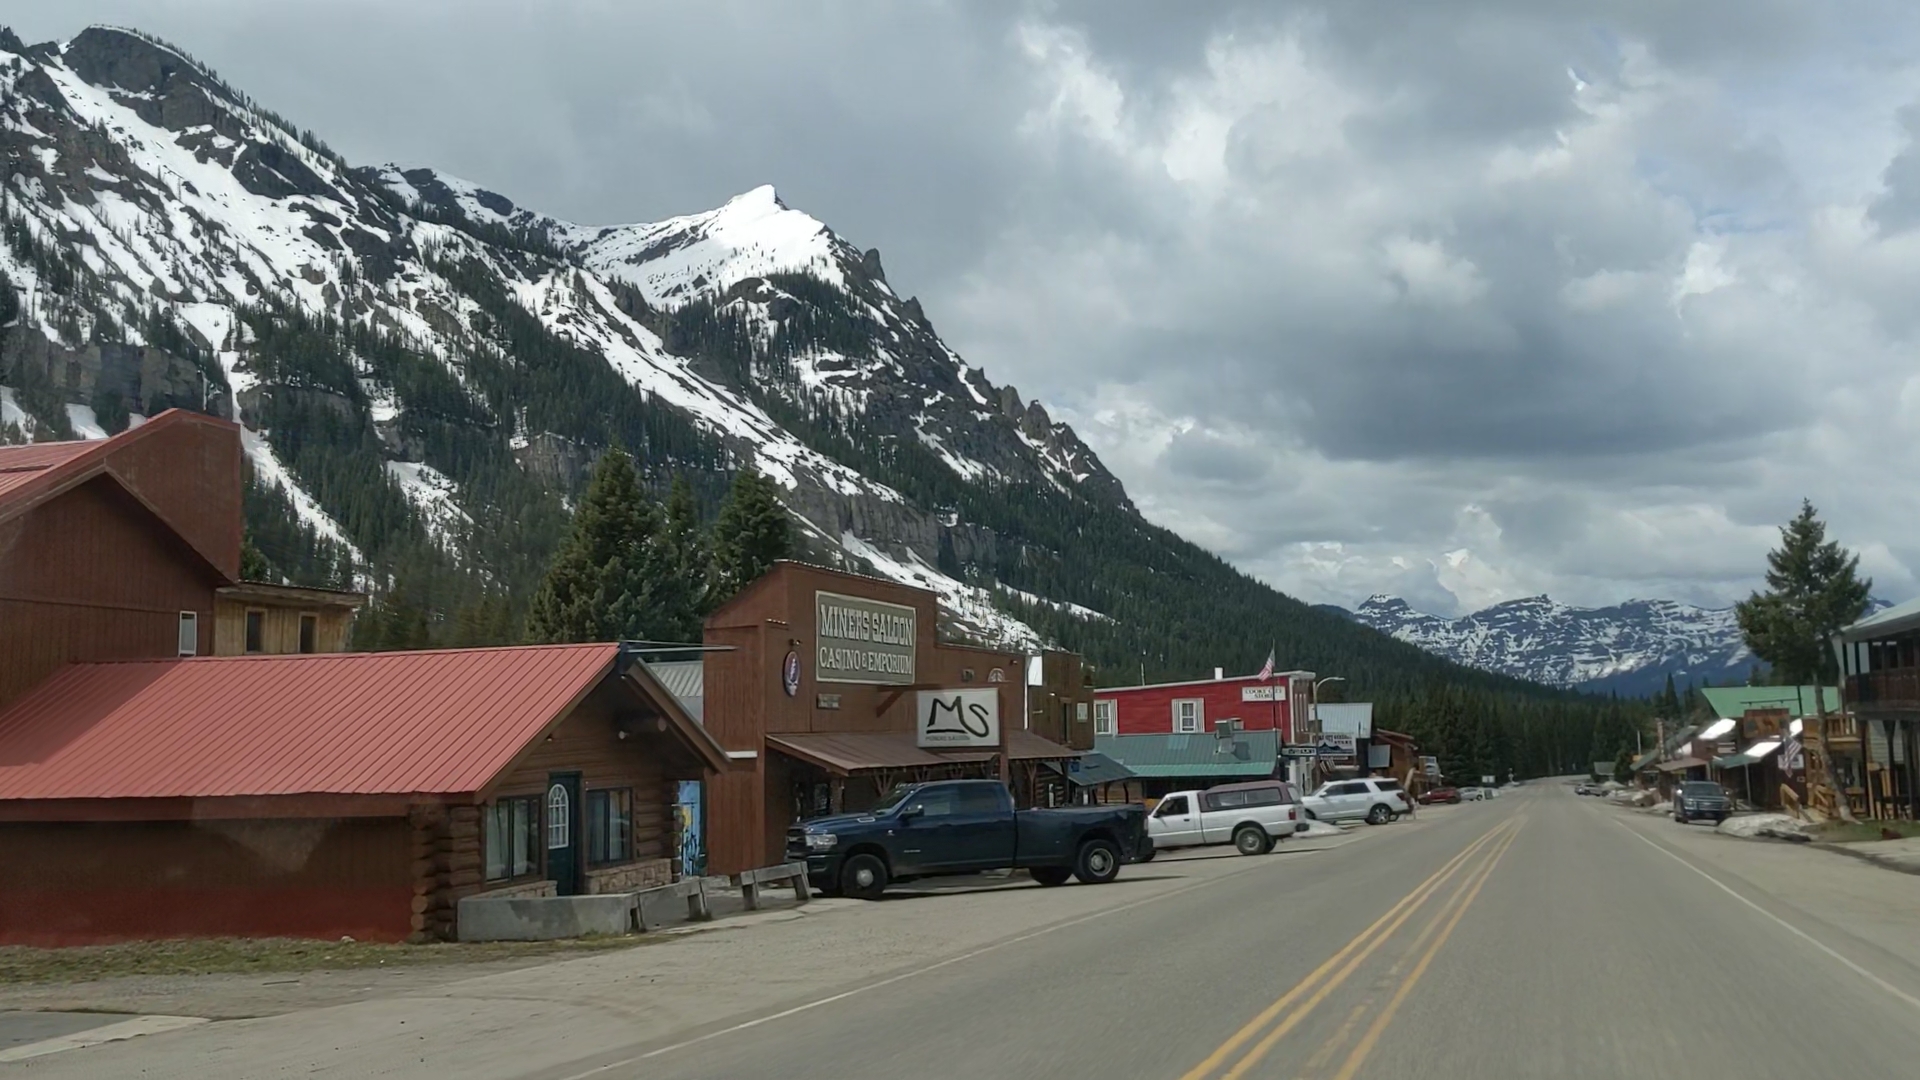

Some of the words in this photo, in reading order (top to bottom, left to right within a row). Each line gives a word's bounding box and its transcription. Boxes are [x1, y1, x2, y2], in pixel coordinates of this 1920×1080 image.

[821, 604, 870, 642] MINERS
[872, 612, 913, 646] SALOON
[819, 646, 861, 671] CASINO
[861, 652, 867, 668] &
[868, 652, 912, 674] EMPORIUM
[926, 695, 990, 738] MS
